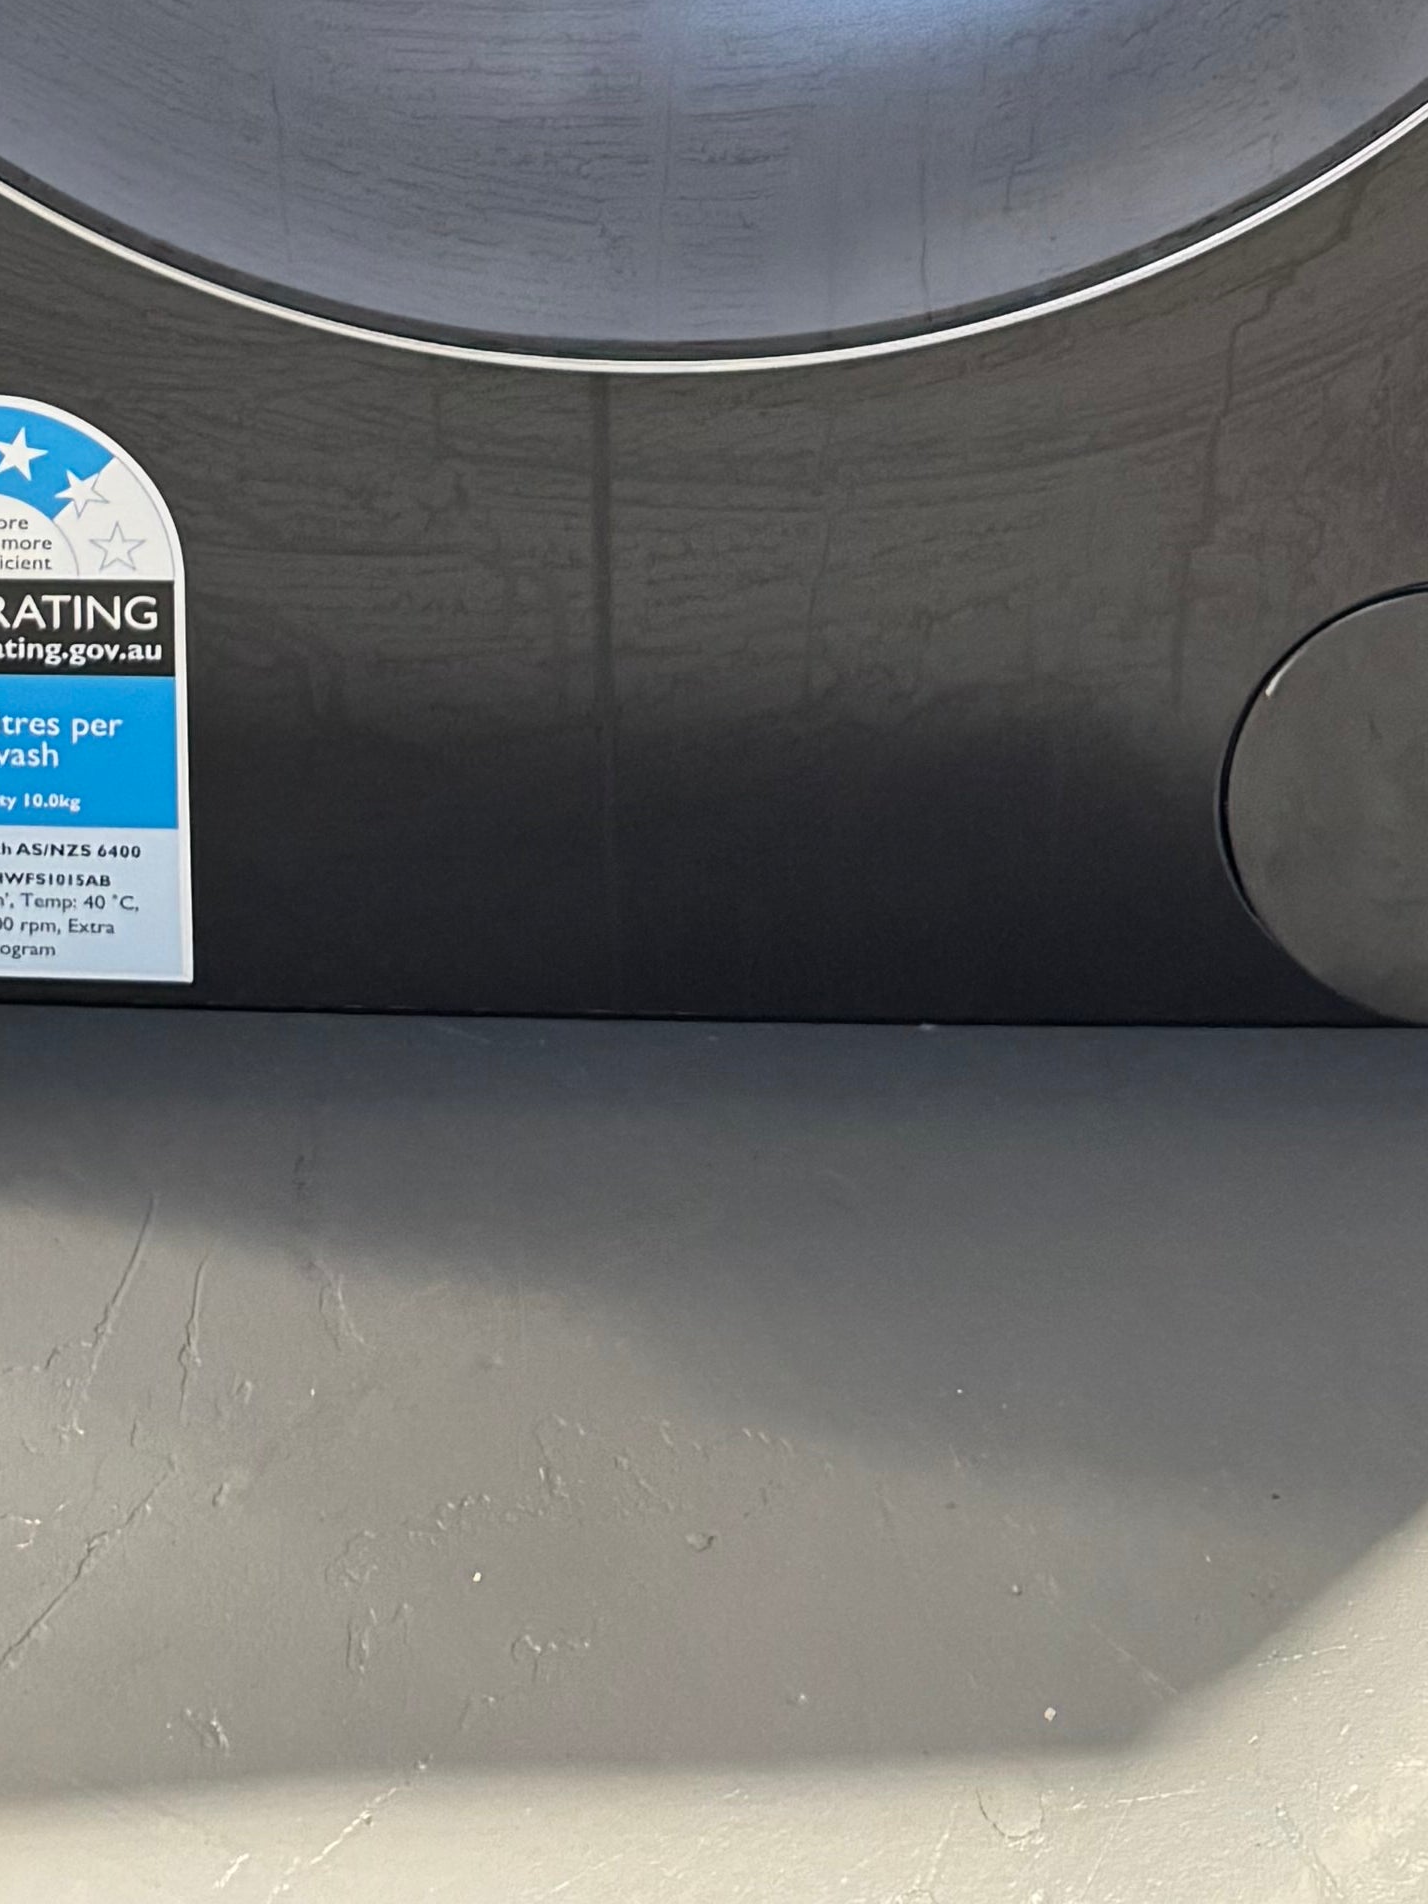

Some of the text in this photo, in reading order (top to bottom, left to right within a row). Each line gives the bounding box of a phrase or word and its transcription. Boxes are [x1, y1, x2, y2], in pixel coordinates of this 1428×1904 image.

[0, 536, 53, 552] more
[71, 715, 124, 745] per
[23, 792, 82, 813] 10.0kg
[15, 842, 92, 858] AS/NZS
[96, 844, 142, 860] 6400
[20, 891, 78, 913] Temp:
[83, 894, 106, 911] 40
[19, 918, 63, 937] rpm,
[67, 918, 116, 935] Extra
